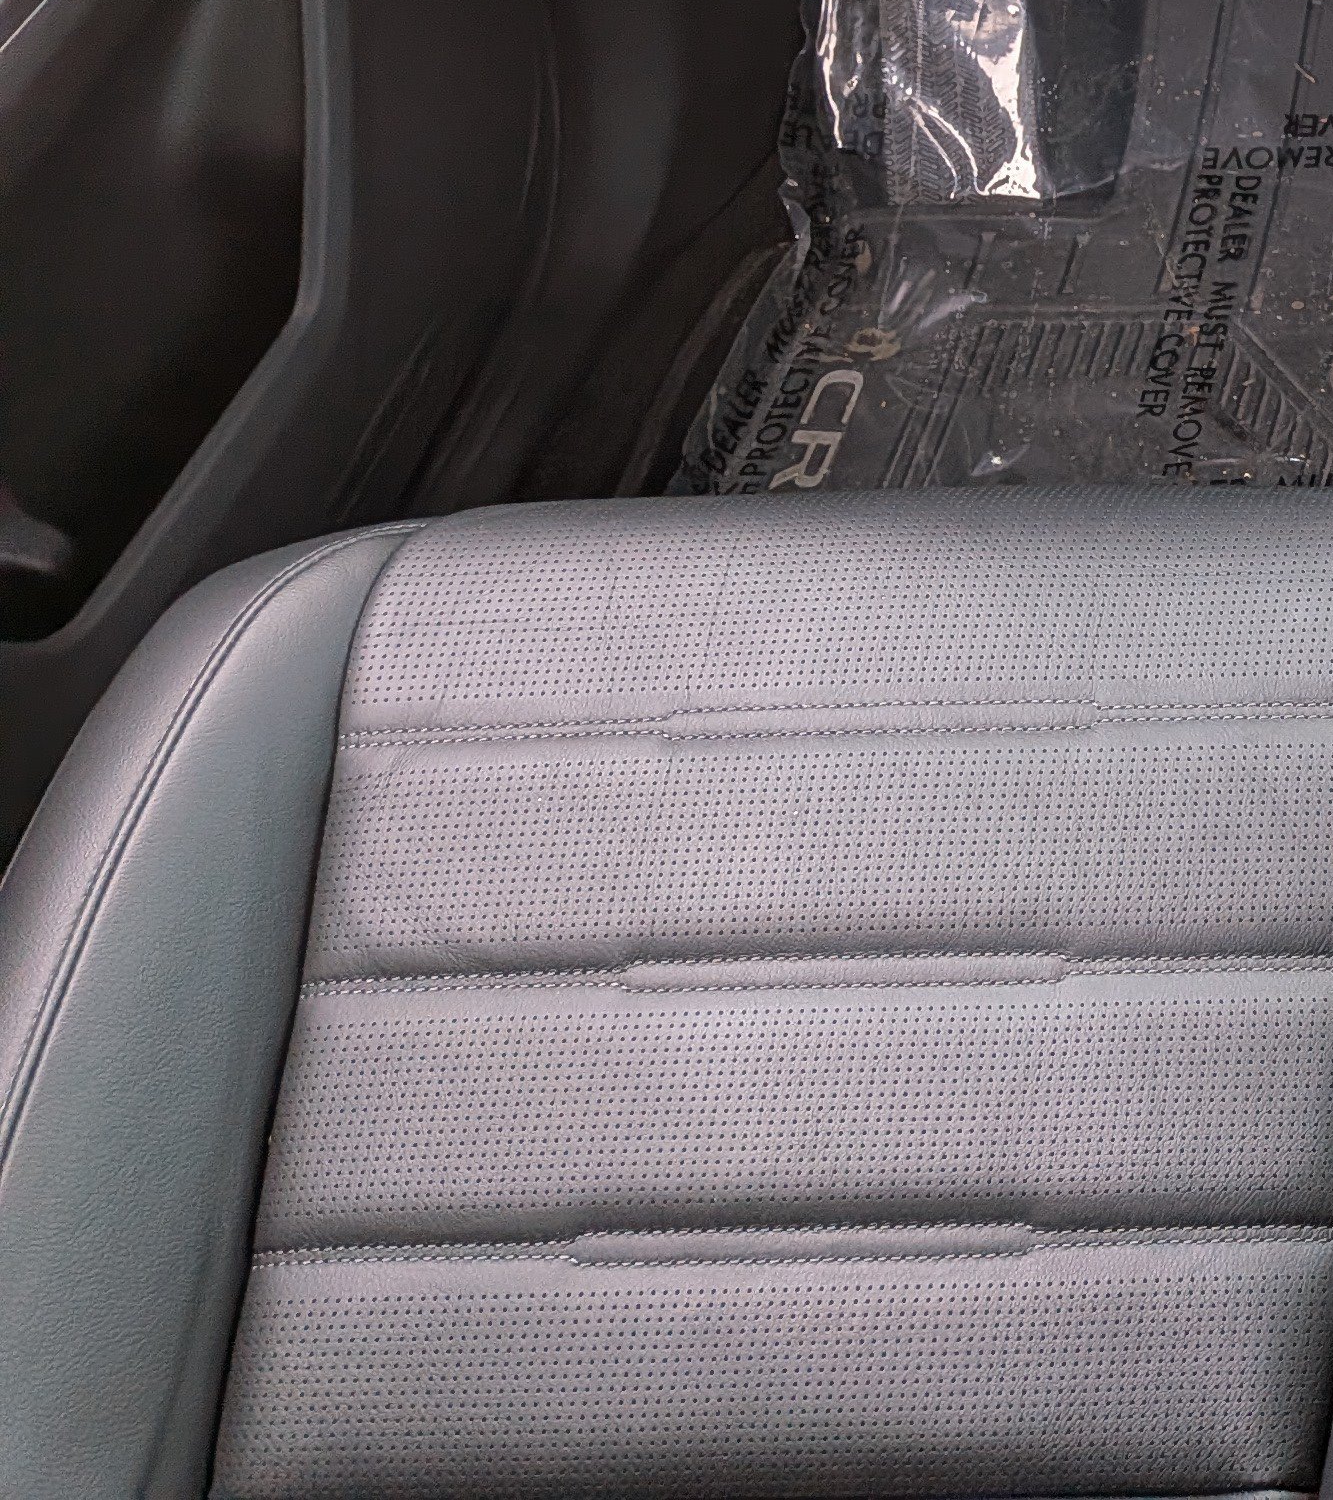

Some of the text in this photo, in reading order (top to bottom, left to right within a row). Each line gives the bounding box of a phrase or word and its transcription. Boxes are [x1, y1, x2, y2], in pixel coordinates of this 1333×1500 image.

[1217, 173, 1261, 264] DEALER
[1137, 326, 1186, 419] COVER
[1161, 363, 1219, 477] REMOVE
